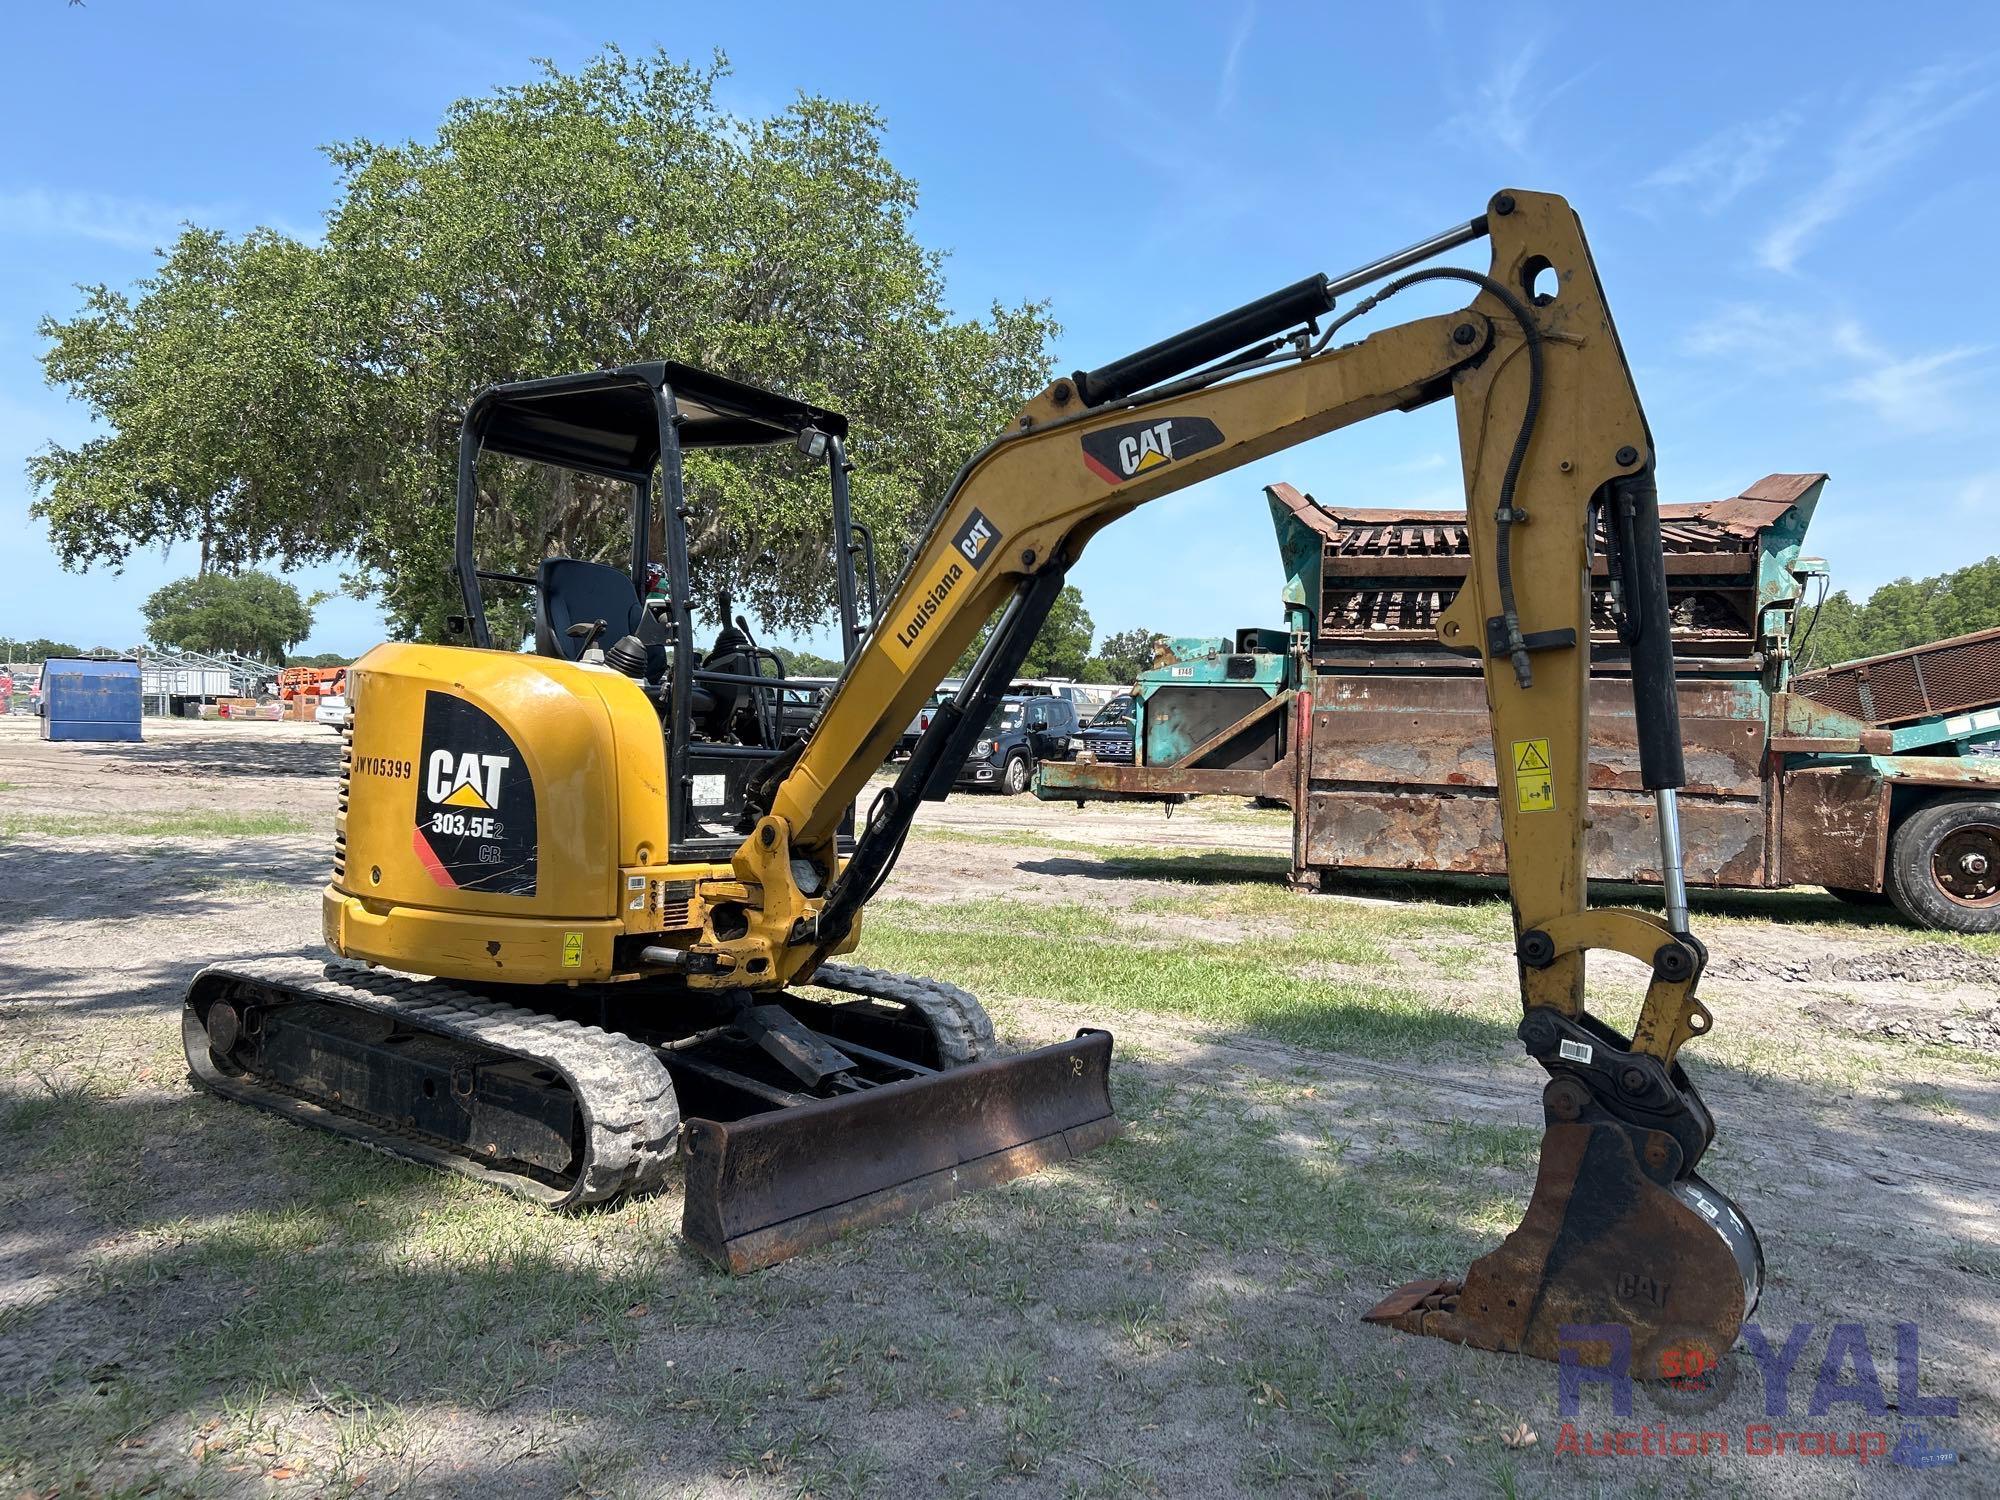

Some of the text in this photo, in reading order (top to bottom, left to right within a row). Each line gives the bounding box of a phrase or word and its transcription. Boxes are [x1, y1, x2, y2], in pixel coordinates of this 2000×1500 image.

[1118, 420, 1173, 475] CAT
[896, 518, 992, 649] Louisiana CAT
[354, 757, 412, 780] JWY05399
[427, 749, 510, 810] CAT
[479, 844, 502, 864] CR
[1616, 1271, 1671, 1308] CAT
